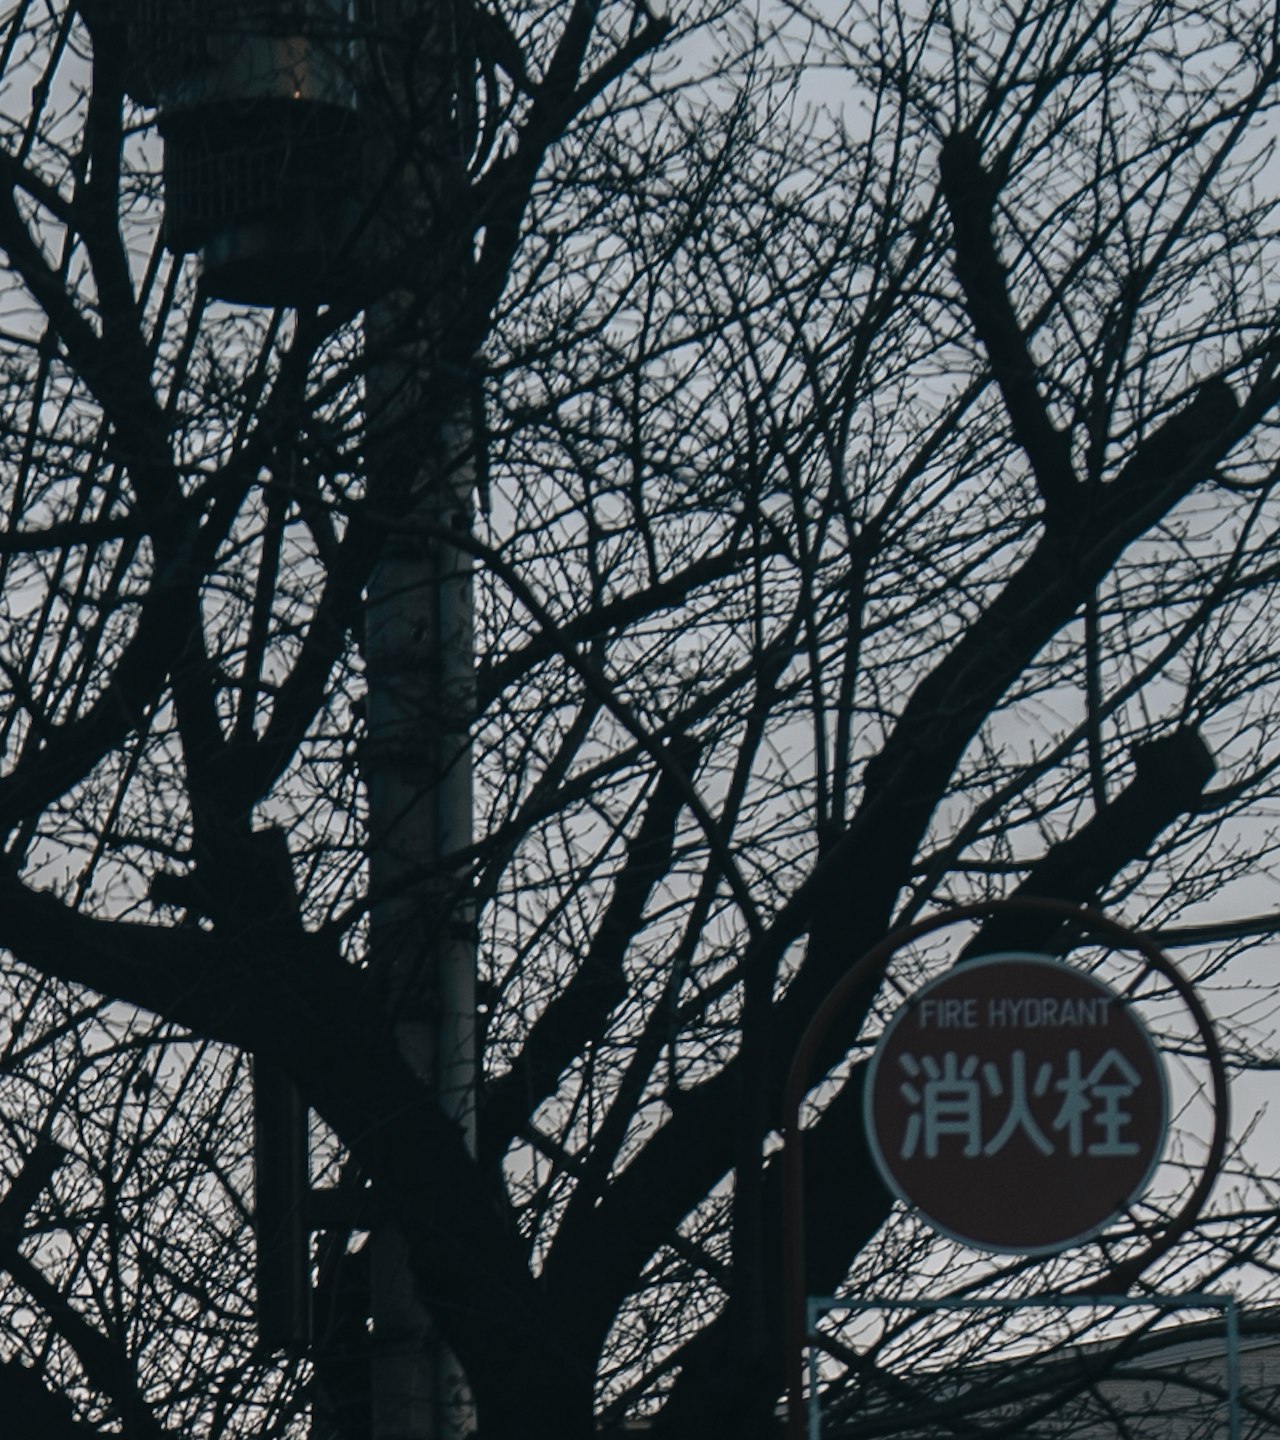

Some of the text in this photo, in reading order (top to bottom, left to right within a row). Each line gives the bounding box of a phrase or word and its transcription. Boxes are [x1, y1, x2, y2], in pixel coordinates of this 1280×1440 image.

[918, 997, 1114, 1030] FIRE HYDRANT
[898, 1047, 1142, 1160] 消火栓
